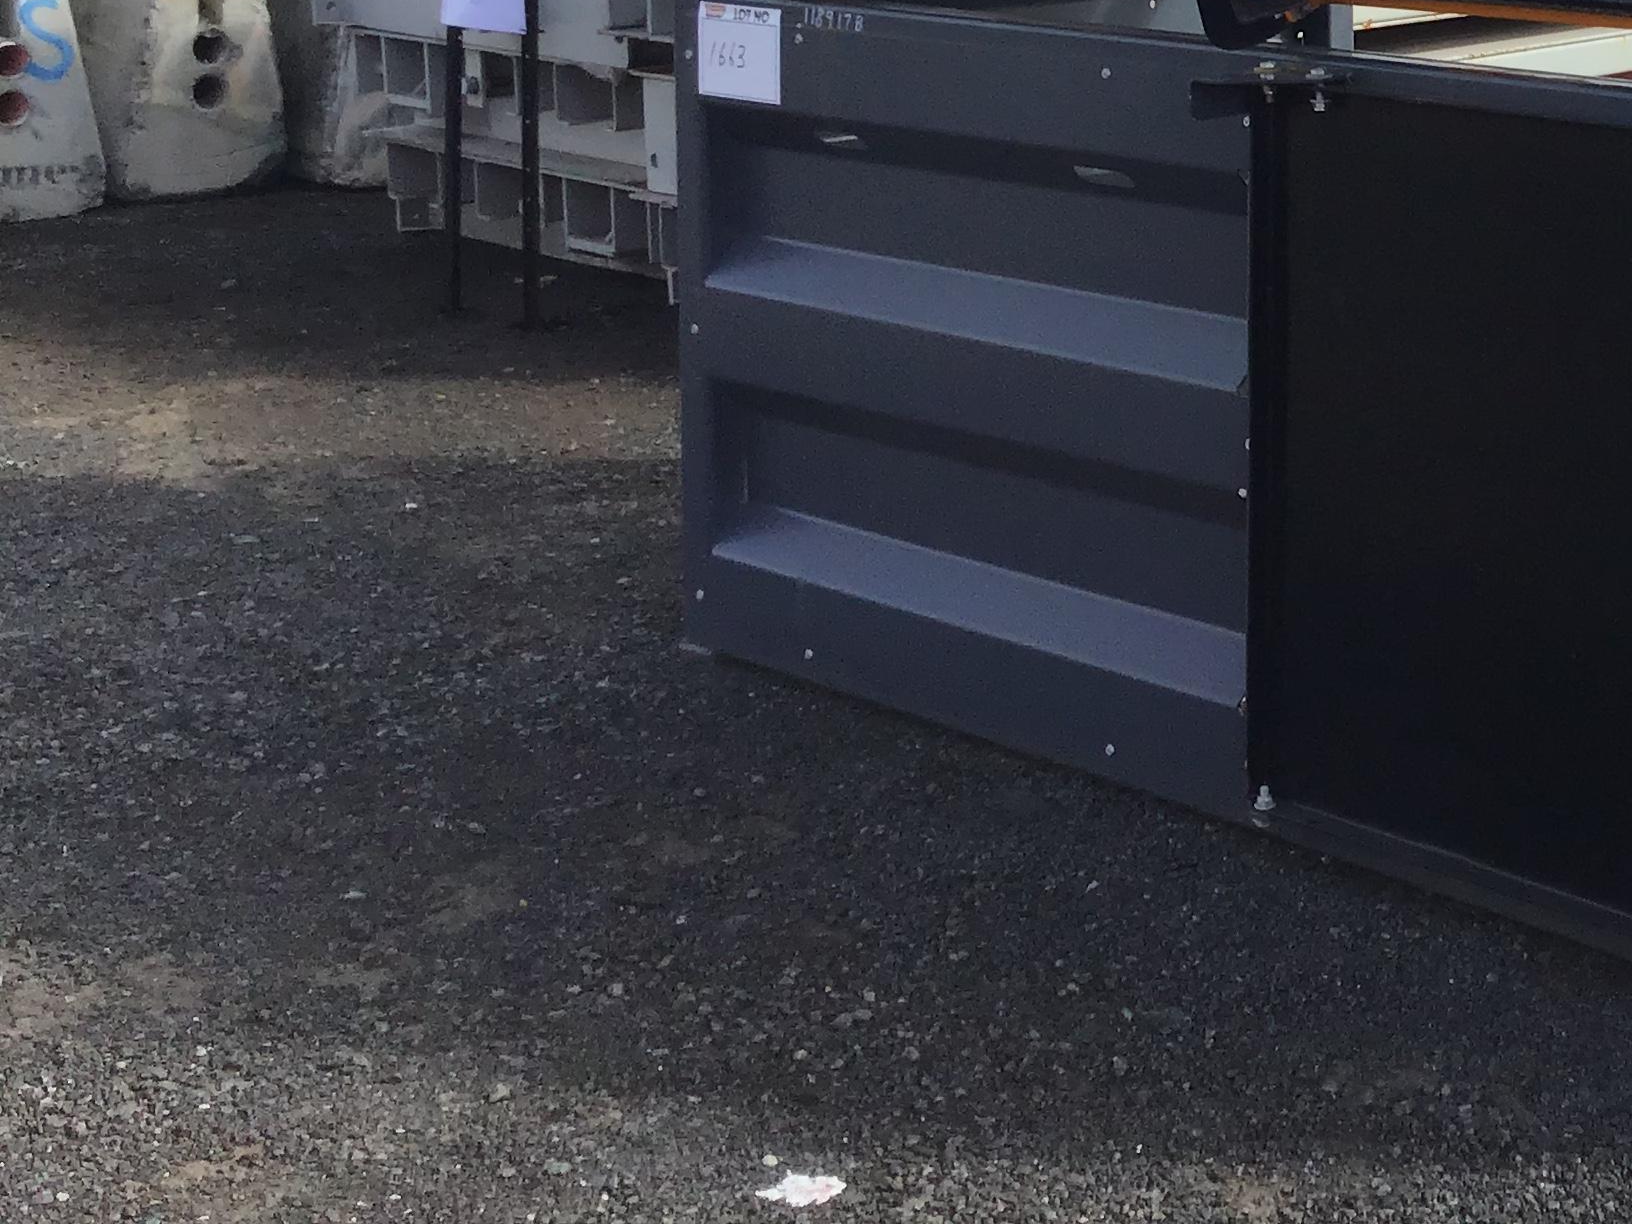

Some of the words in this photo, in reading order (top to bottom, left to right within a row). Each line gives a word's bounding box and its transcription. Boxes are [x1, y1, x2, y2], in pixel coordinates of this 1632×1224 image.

[733, 7, 752, 21] LOT
[754, 9, 770, 24] NO
[709, 41, 746, 69] 1663
